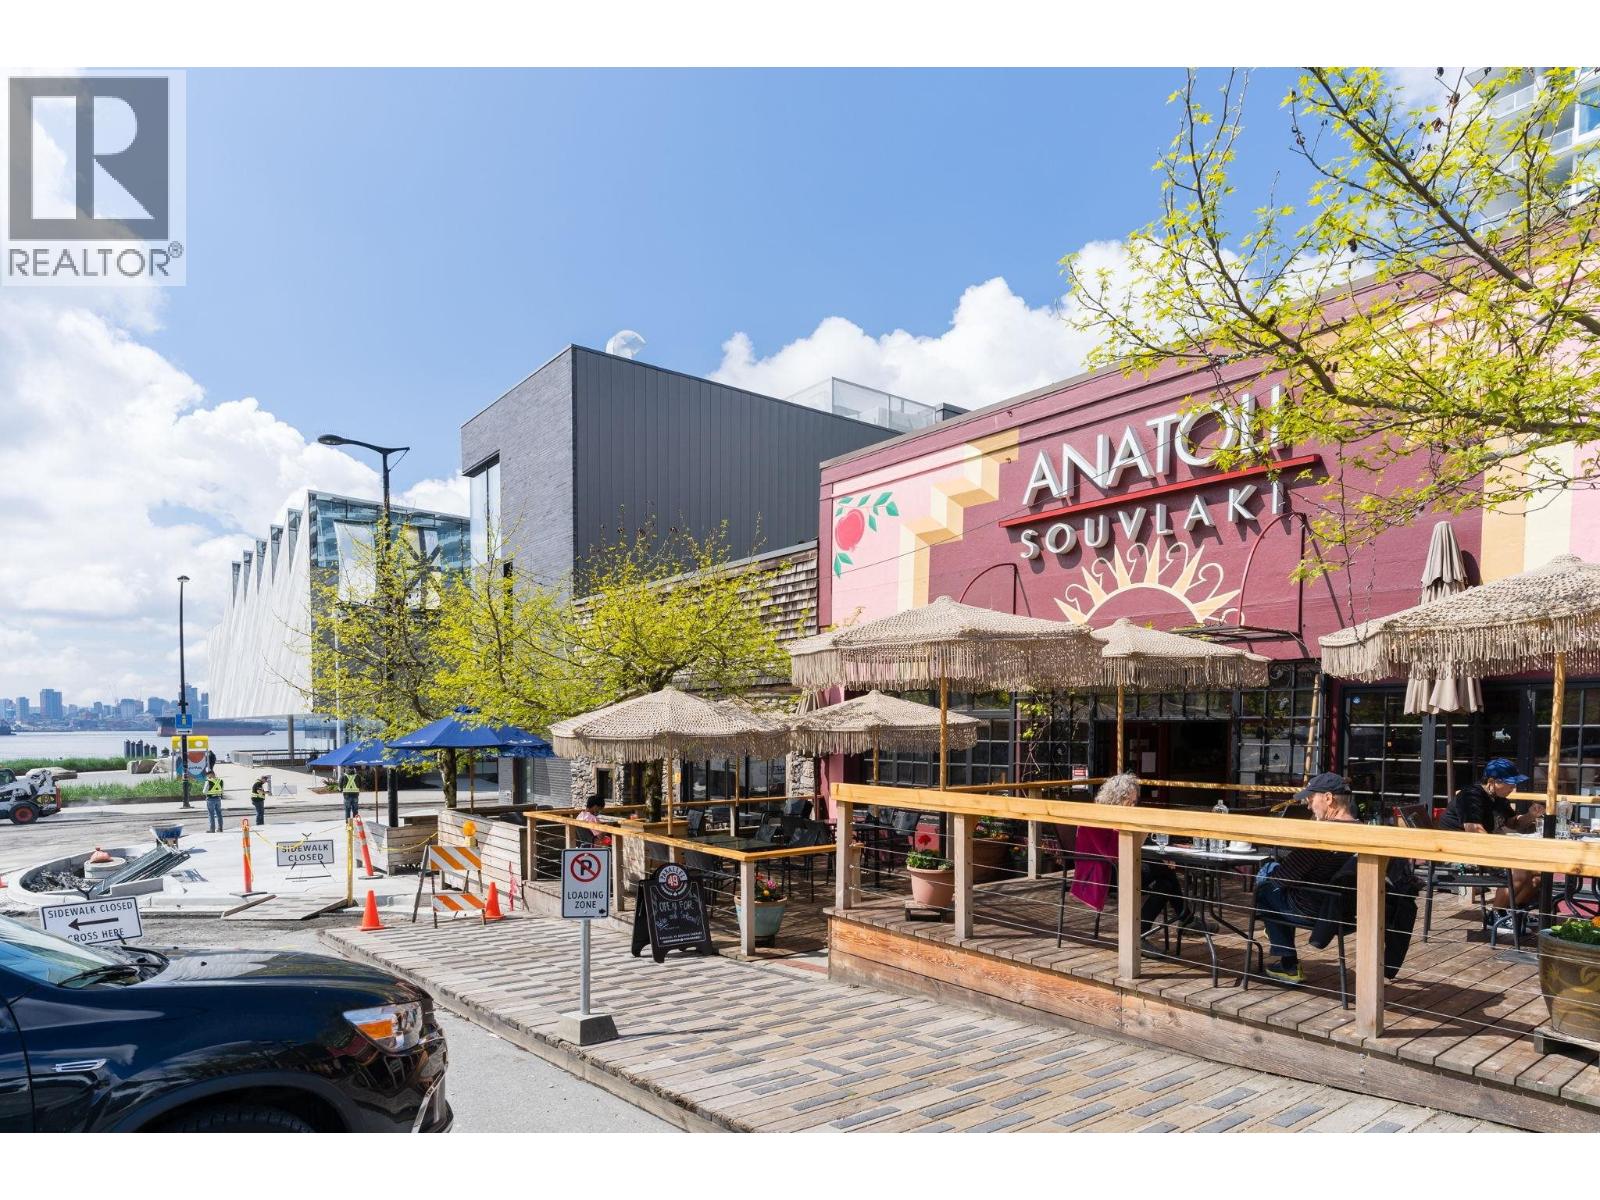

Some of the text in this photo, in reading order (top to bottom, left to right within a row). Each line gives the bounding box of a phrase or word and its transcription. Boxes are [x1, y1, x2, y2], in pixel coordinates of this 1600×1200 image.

[1022, 384, 1286, 506] ANATOLI
[1020, 481, 1285, 560] SOUVLAKI
[281, 844, 329, 853] SIDEWALK
[288, 853, 324, 862] CLOSED
[567, 891, 604, 900] LOADING
[574, 900, 597, 909] ZONE
[47, 901, 133, 919] SIDEWALK CLOSED
[102, 928, 125, 938] HERE
